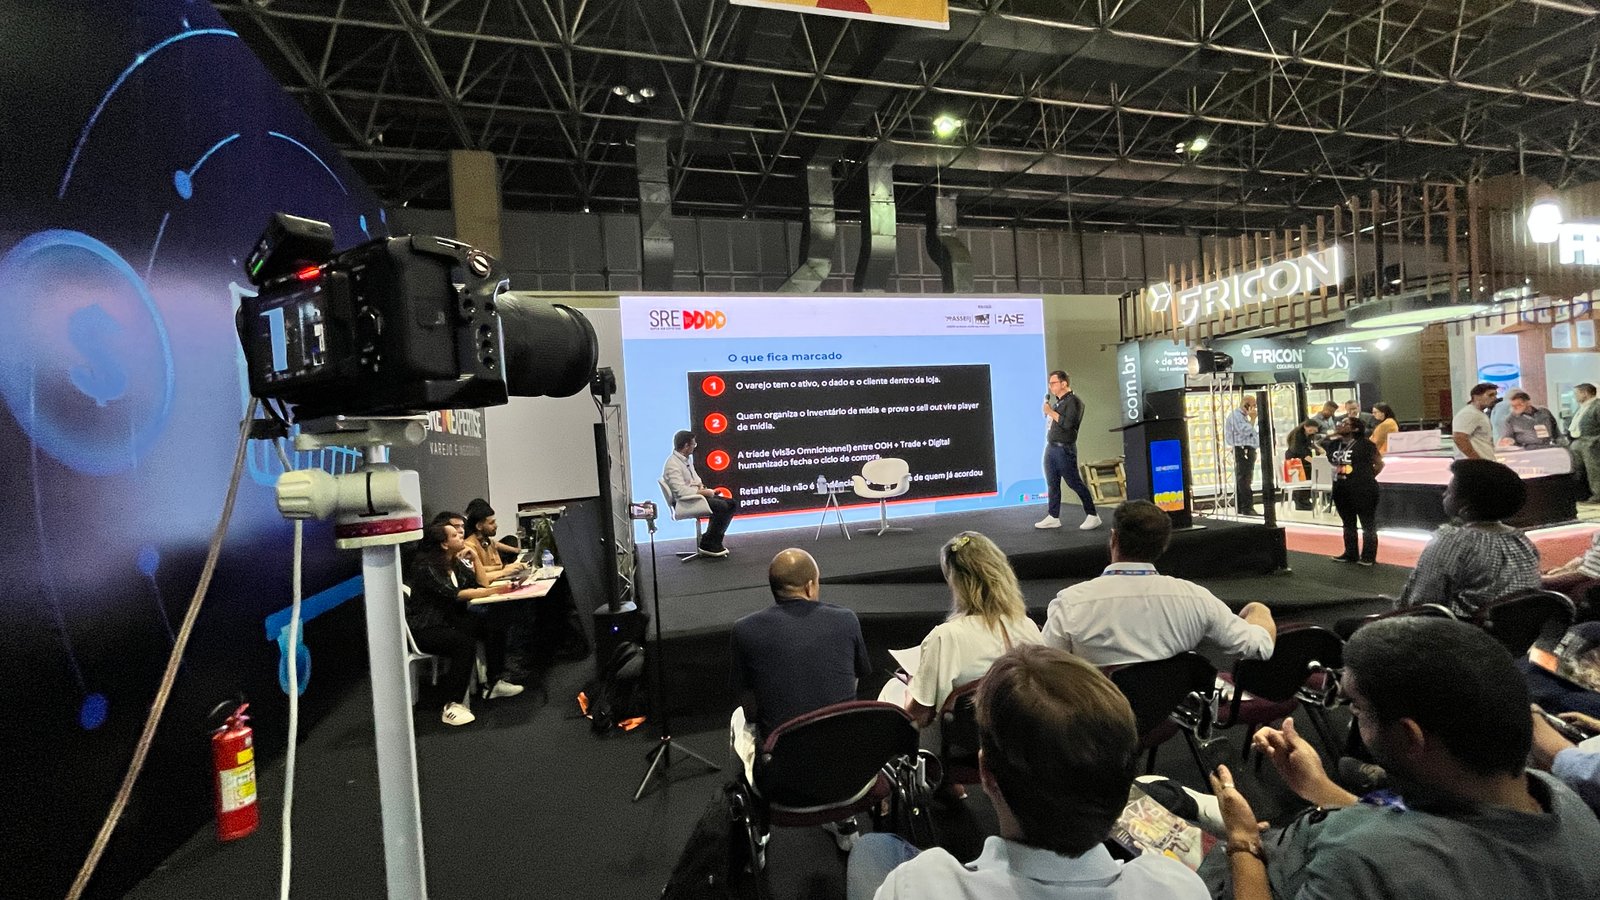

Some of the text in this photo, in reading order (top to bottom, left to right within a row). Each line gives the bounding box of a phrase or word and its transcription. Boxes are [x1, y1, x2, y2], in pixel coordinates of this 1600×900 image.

[1176, 246, 1339, 325] FRICON
[650, 310, 680, 327] SRE
[728, 352, 842, 364] O que fica marcado
[1252, 348, 1303, 364] FRICON
[736, 382, 744, 390] O
[745, 381, 771, 390] varejo
[798, 380, 820, 388] ativo,
[890, 376, 914, 384] dentro
[926, 376, 940, 384] loja.
[736, 412, 762, 420] Quem
[764, 410, 798, 420] organiza
[806, 408, 846, 416] inventário
[848, 406, 858, 414] de
[859, 406, 880, 414] mídia
[888, 406, 908, 414] prova
[916, 404, 928, 412] sell
[958, 402, 980, 411] player
[737, 422, 776, 431] de mídia.
[738, 451, 744, 459] A
[746, 448, 770, 458] tríade
[772, 448, 796, 458] (visão
[797, 444, 852, 455] Omnichannel)
[874, 442, 893, 450] OOH
[928, 438, 950, 448] Digital
[738, 460, 788, 470] humanizado
[790, 456, 812, 466] fecha
[820, 456, 838, 464] ciclo
[840, 454, 850, 463] de
[924, 472, 946, 482] quem
[946, 471, 954, 480] já
[954, 470, 983, 478] acordou
[740, 487, 764, 496] Retail
[764, 485, 790, 494] Media
[793, 483, 808, 491] não
[810, 482, 815, 490] é
[740, 496, 780, 508] para isso.
